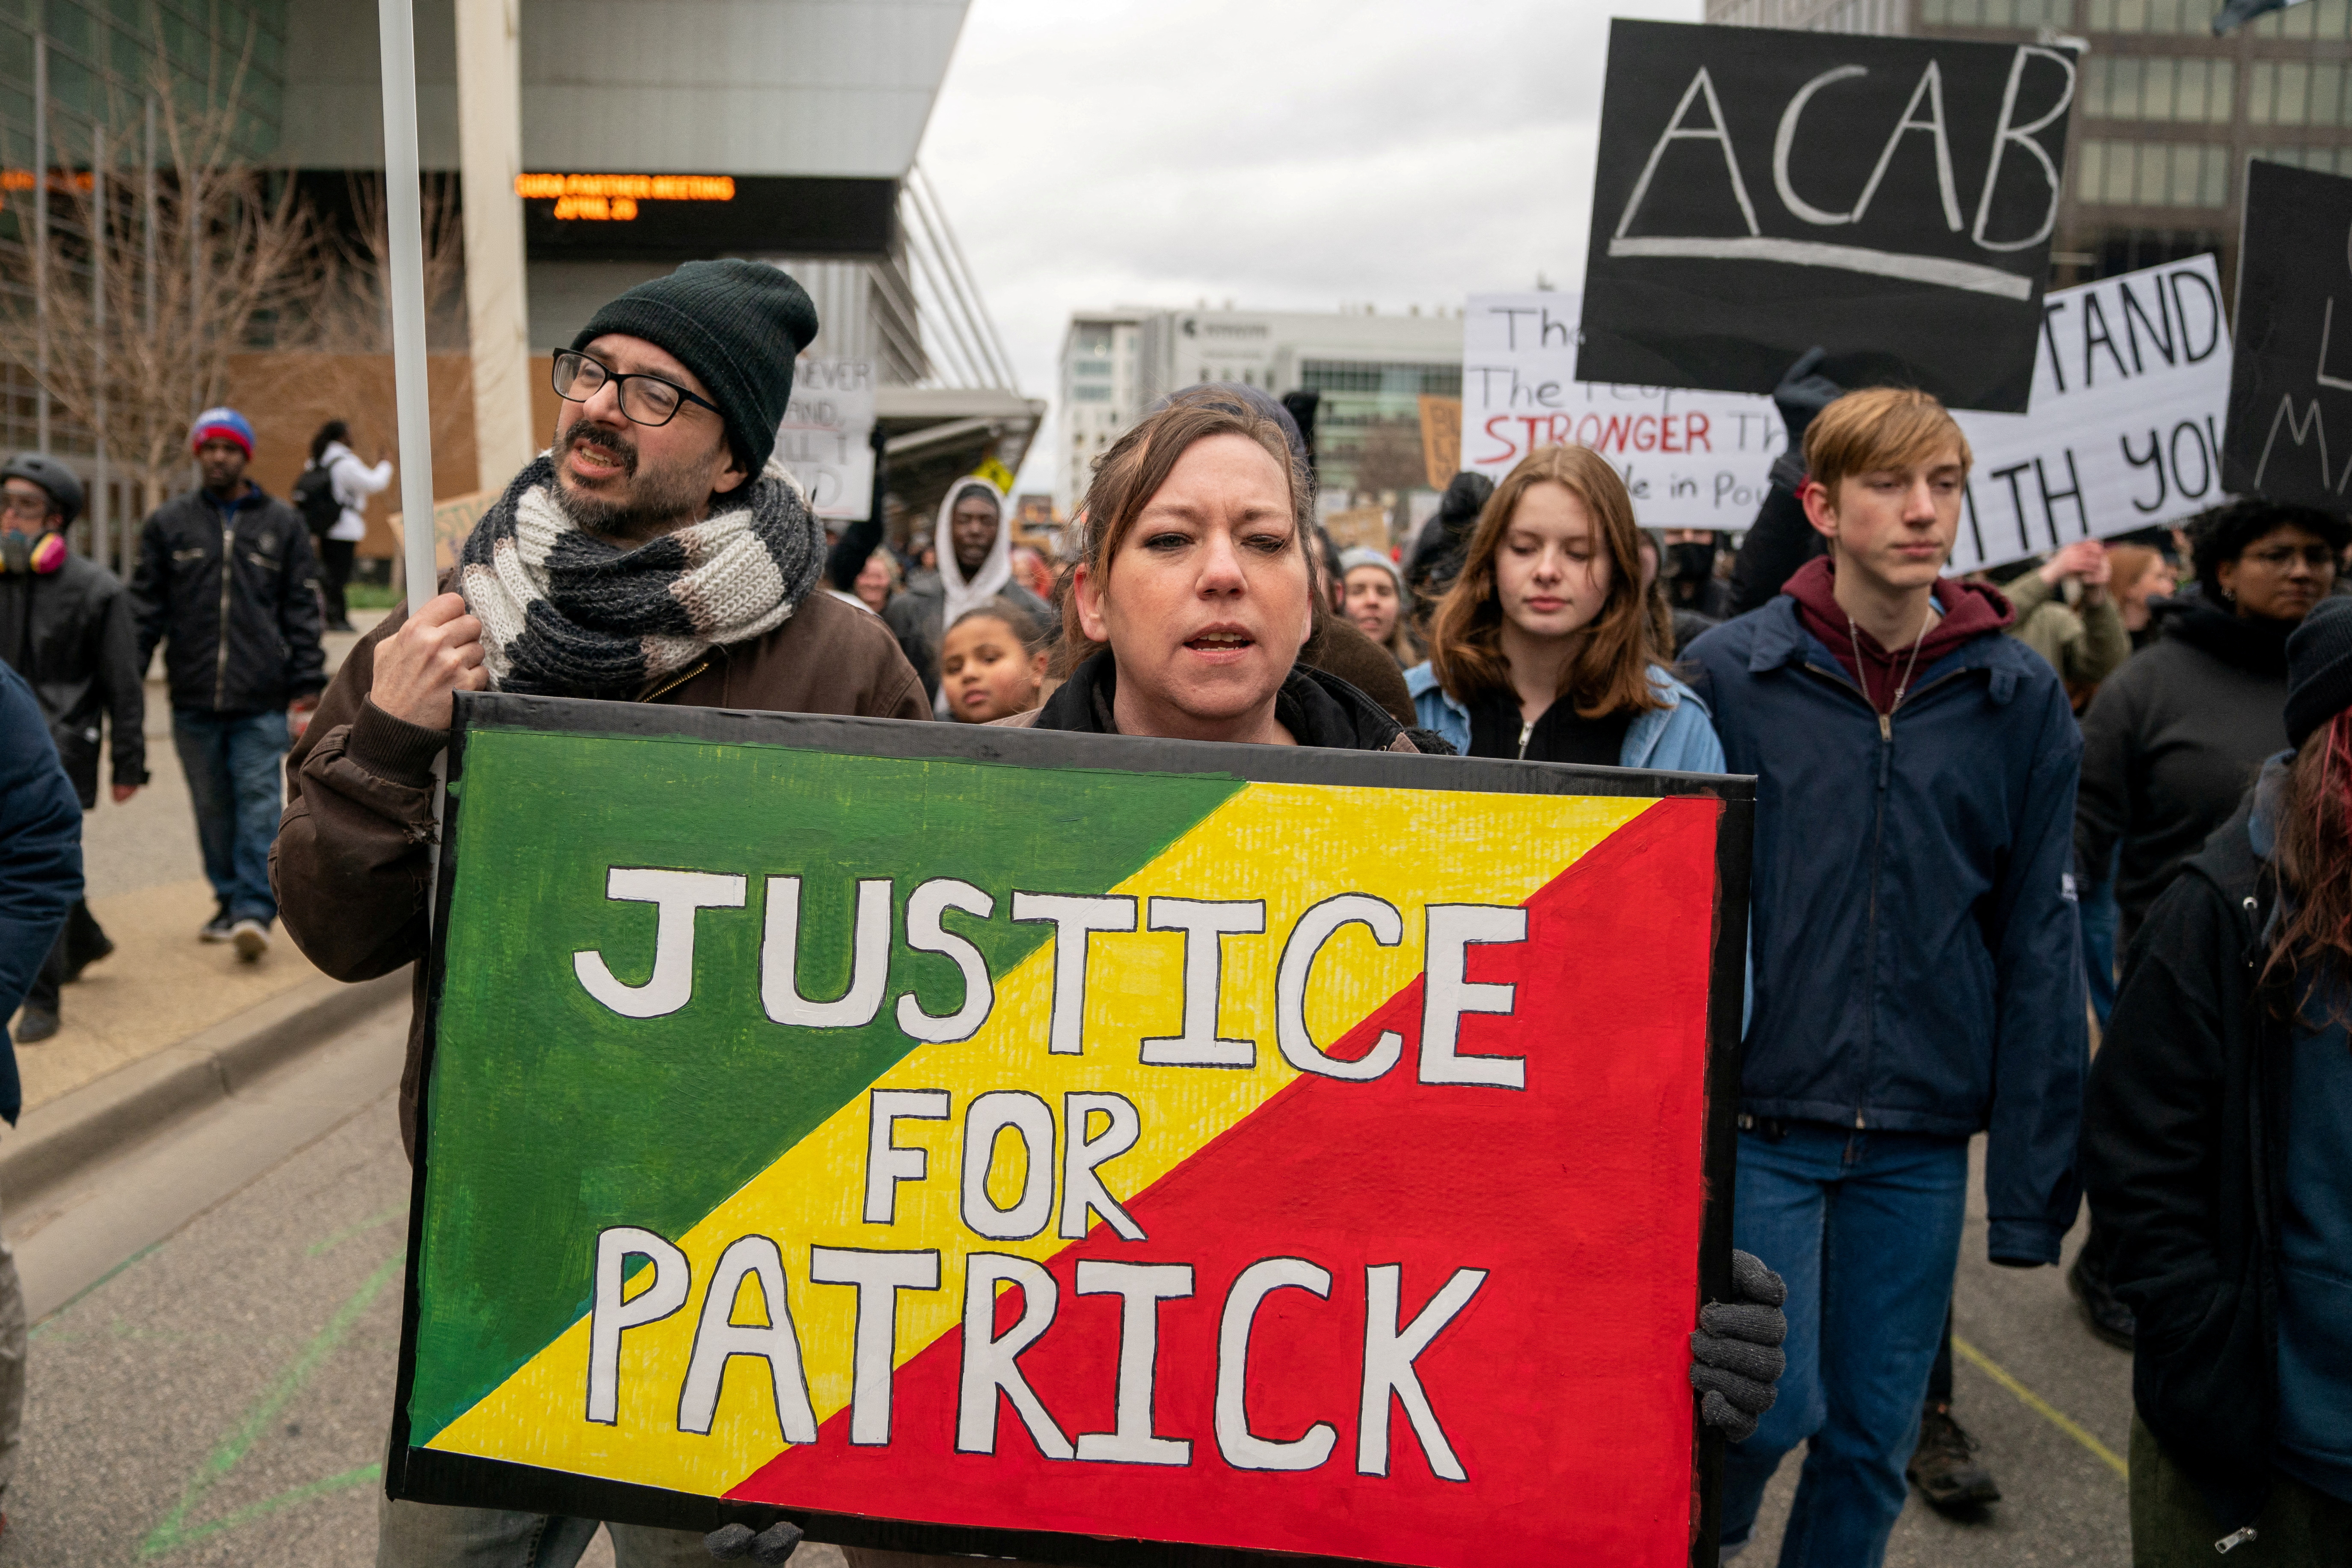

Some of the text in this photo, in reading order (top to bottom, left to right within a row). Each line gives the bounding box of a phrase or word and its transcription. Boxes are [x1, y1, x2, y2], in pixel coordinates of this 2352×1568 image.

[1615, 44, 2076, 252] ACAB
[1466, 364, 1564, 409] The
[1474, 410, 1711, 465] STRONGER
[1670, 472, 1697, 498] in
[1945, 448, 2088, 566] ITH
[572, 865, 1528, 1089] JUSTICE
[862, 1088, 1148, 1242] FOR
[585, 1224, 1491, 1482] PATRICK
